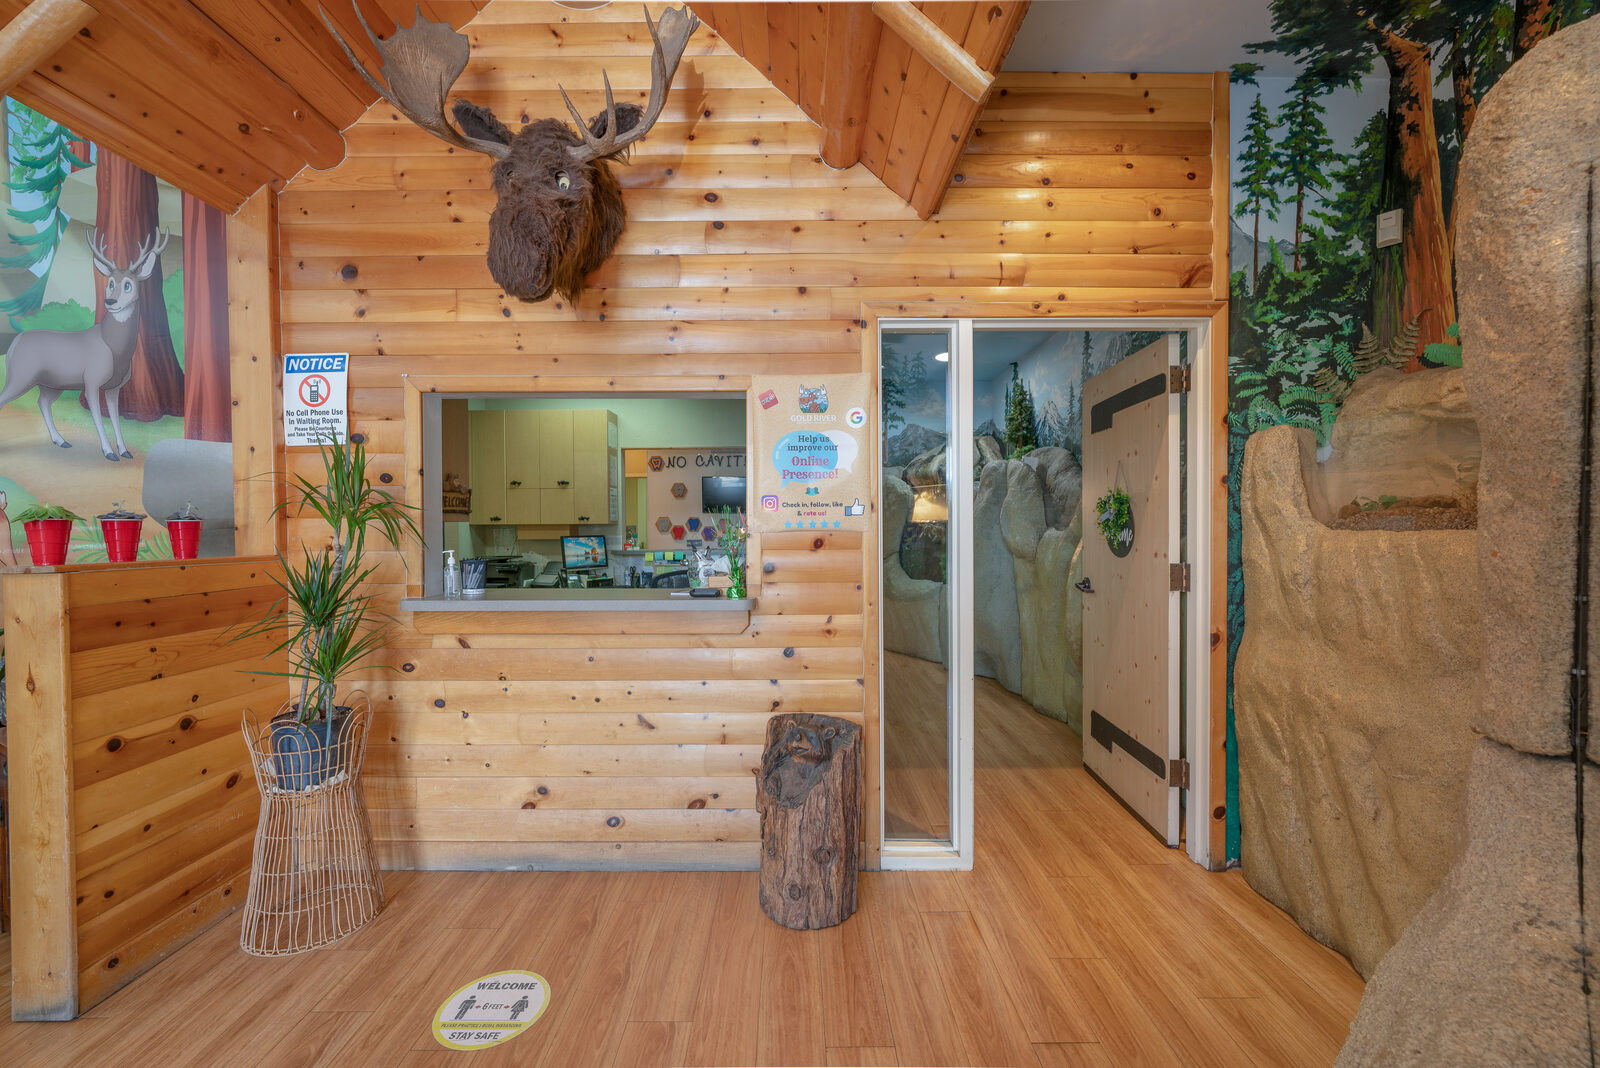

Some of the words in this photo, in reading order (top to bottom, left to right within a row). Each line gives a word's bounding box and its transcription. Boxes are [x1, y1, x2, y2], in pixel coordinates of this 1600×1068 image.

[288, 358, 344, 371] NOTICE
[296, 418, 321, 426] Waiting
[790, 414, 812, 422] GOLD
[814, 414, 837, 422] RIVER
[798, 435, 818, 444] Help
[787, 444, 822, 453] improve
[666, 456, 687, 468] NO
[792, 456, 830, 466] Online
[782, 468, 839, 480] Presence!
[477, 982, 538, 990] WELCOME
[482, 1002, 490, 1010] 6
[448, 1031, 474, 1040] STAY
[474, 1031, 501, 1040] SAFE
